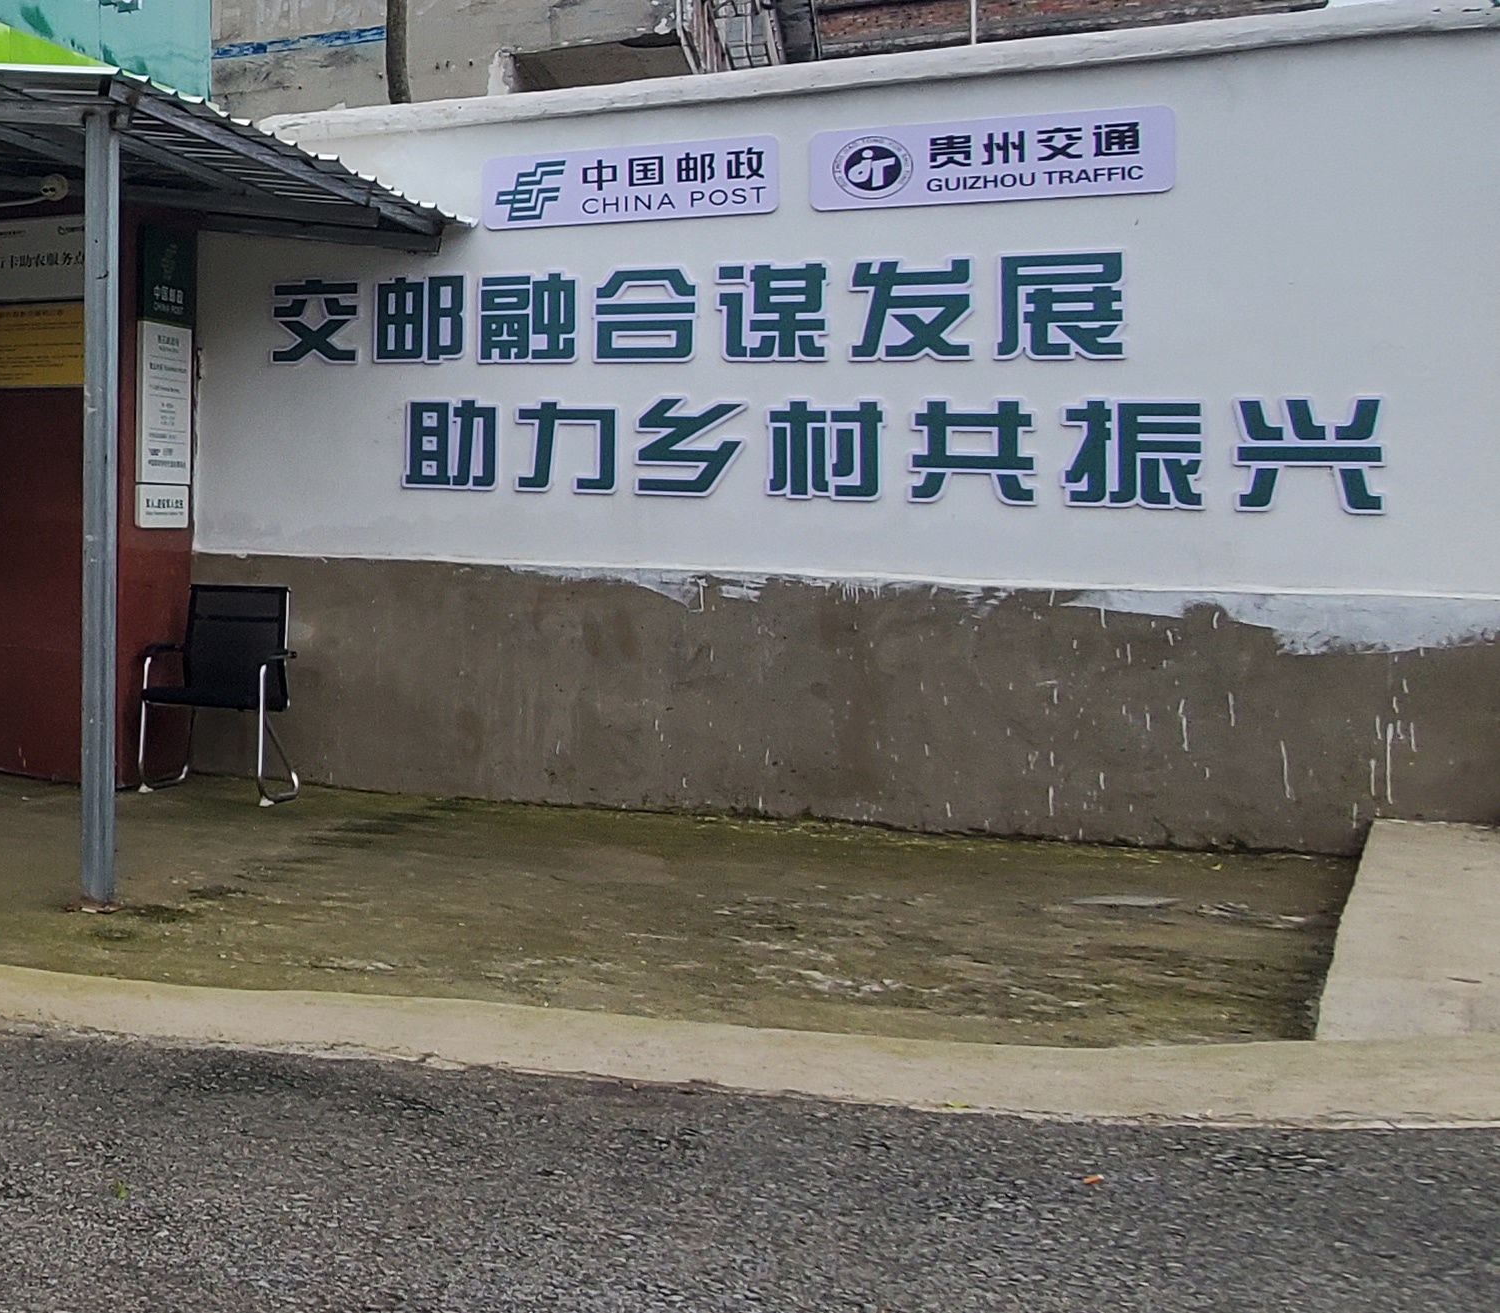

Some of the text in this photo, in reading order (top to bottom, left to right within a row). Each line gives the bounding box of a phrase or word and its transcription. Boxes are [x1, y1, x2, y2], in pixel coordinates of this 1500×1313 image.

[929, 121, 1140, 169] 贵州交通
[582, 146, 764, 191] 中国邮政
[927, 164, 1144, 193] GUIZHOU TRAFFIC
[581, 186, 767, 214] CHINA POST
[272, 252, 1127, 364] 交邮融合谋发展
[406, 396, 1386, 512] 助力乡村共振兴
